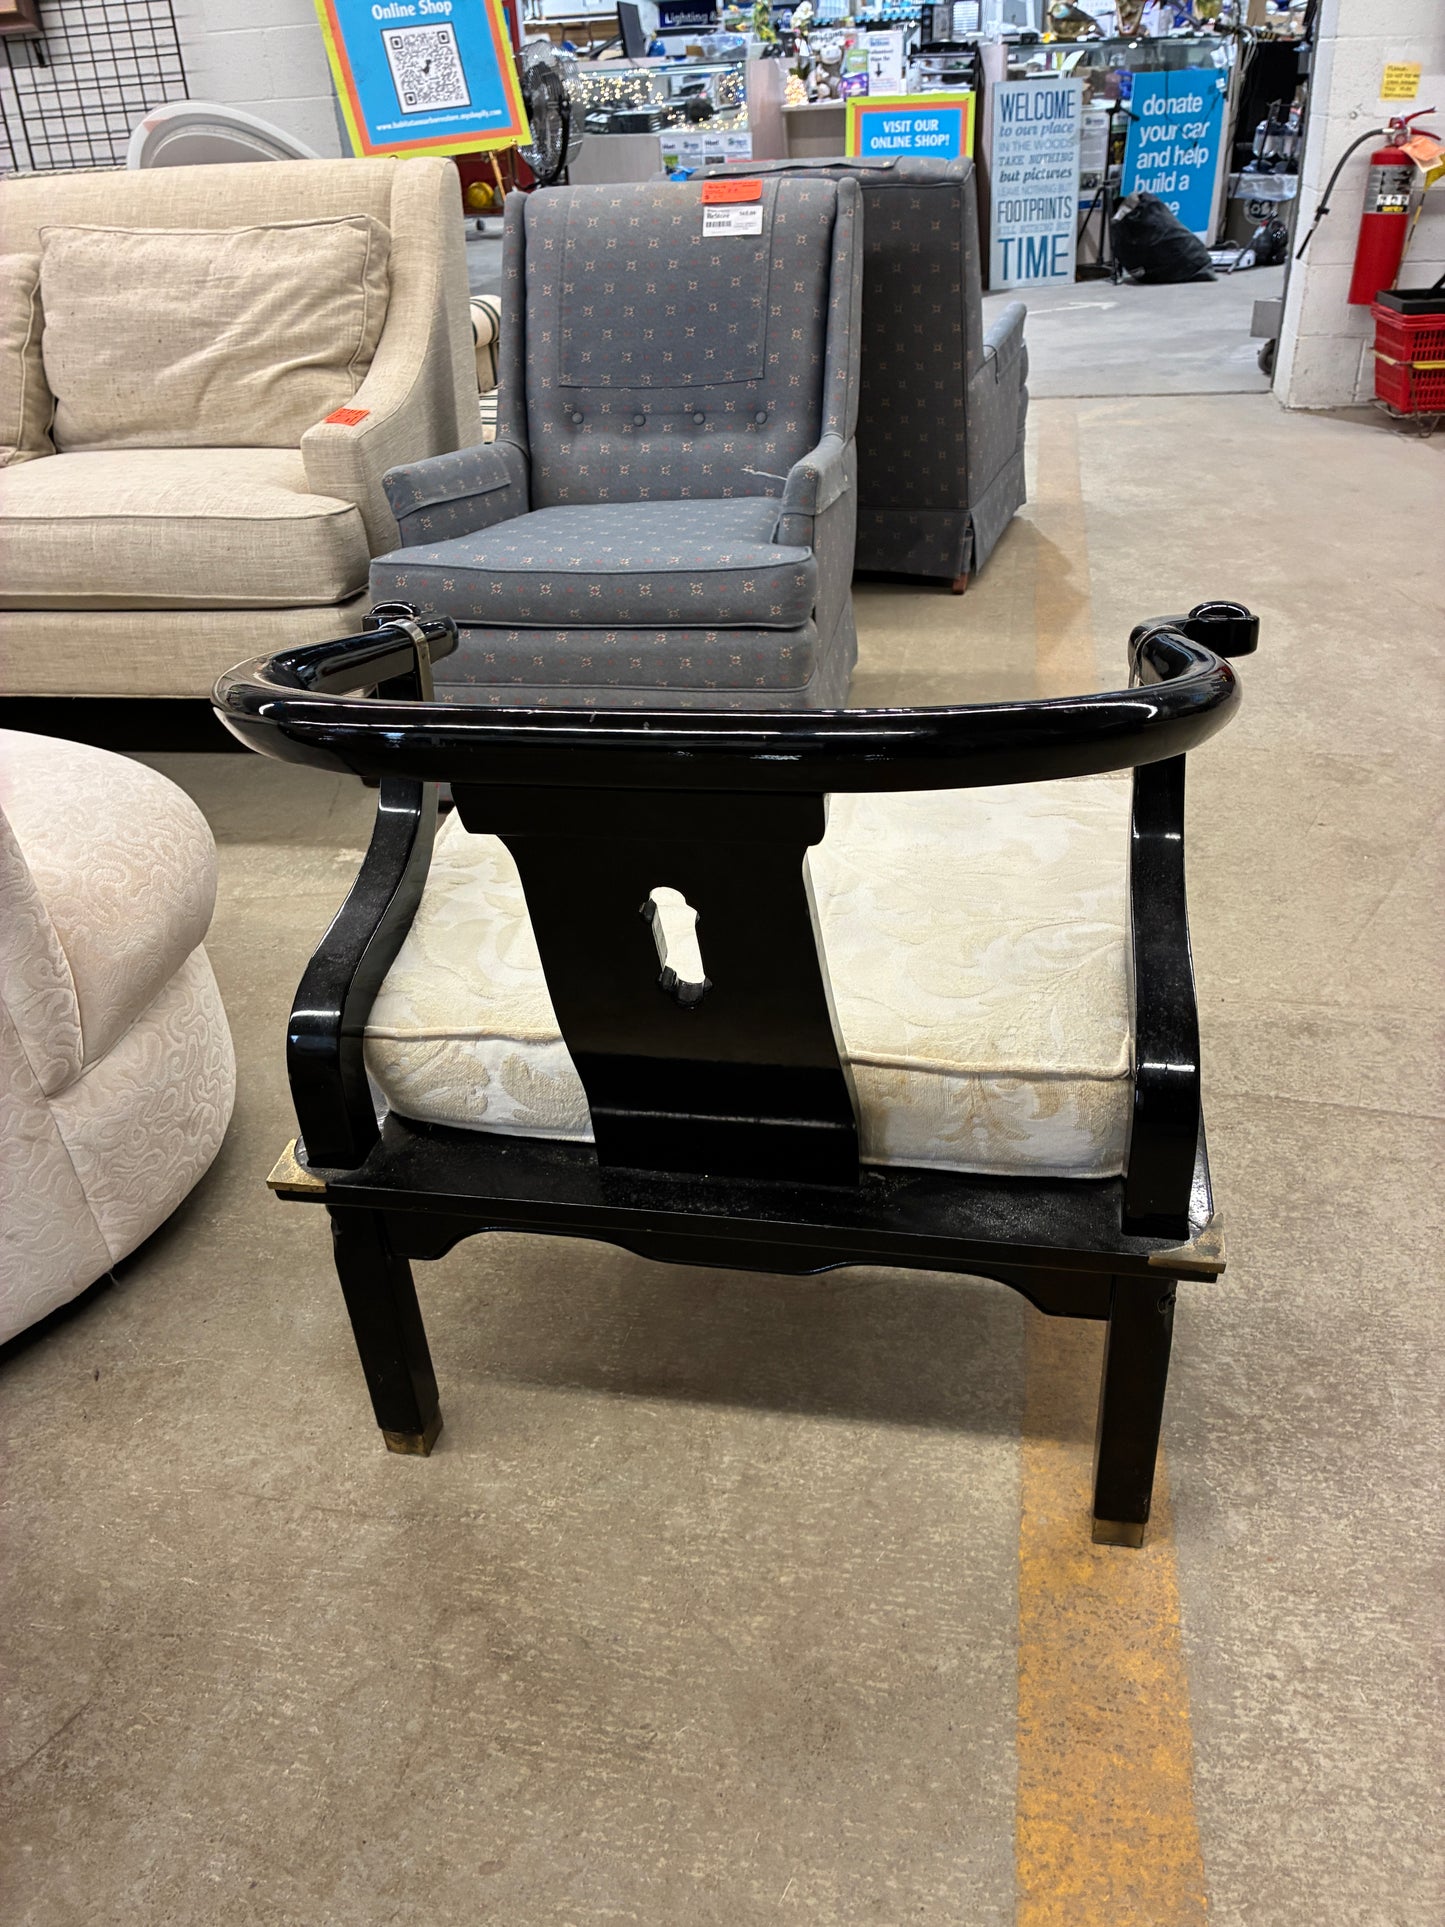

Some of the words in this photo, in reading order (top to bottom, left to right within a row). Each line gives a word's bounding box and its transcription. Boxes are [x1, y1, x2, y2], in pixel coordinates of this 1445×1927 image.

[372, 1, 416, 20] Online
[419, 0, 453, 15] Shop
[664, 10, 707, 26] Lighting
[1000, 90, 1076, 122] WELCOME
[1143, 93, 1203, 116] donate
[883, 120, 912, 133] VISIT
[914, 119, 939, 132] OUR
[1000, 125, 1012, 137] to
[1015, 125, 1038, 136] our
[1041, 122, 1074, 137] place
[1139, 123, 1178, 147] your
[1181, 120, 1210, 139] car
[870, 135, 912, 149] ONLINE
[914, 134, 950, 147] SHOP!
[999, 142, 1010, 152] IN
[1012, 141, 1032, 151] THE
[1034, 138, 1075, 150] WOODS
[999, 155, 1025, 166] TAKE
[1028, 152, 1074, 165] NOTHING
[1136, 145, 1173, 169] and
[1173, 144, 1209, 168] help
[999, 170, 1020, 183] but
[1023, 167, 1072, 184] pictures
[1134, 171, 1177, 193] build
[1178, 174, 1190, 191] a
[1022, 184, 1056, 195] NOTHING
[997, 196, 1072, 223] FOOTPRINTS
[997, 233, 1070, 280] TIME
